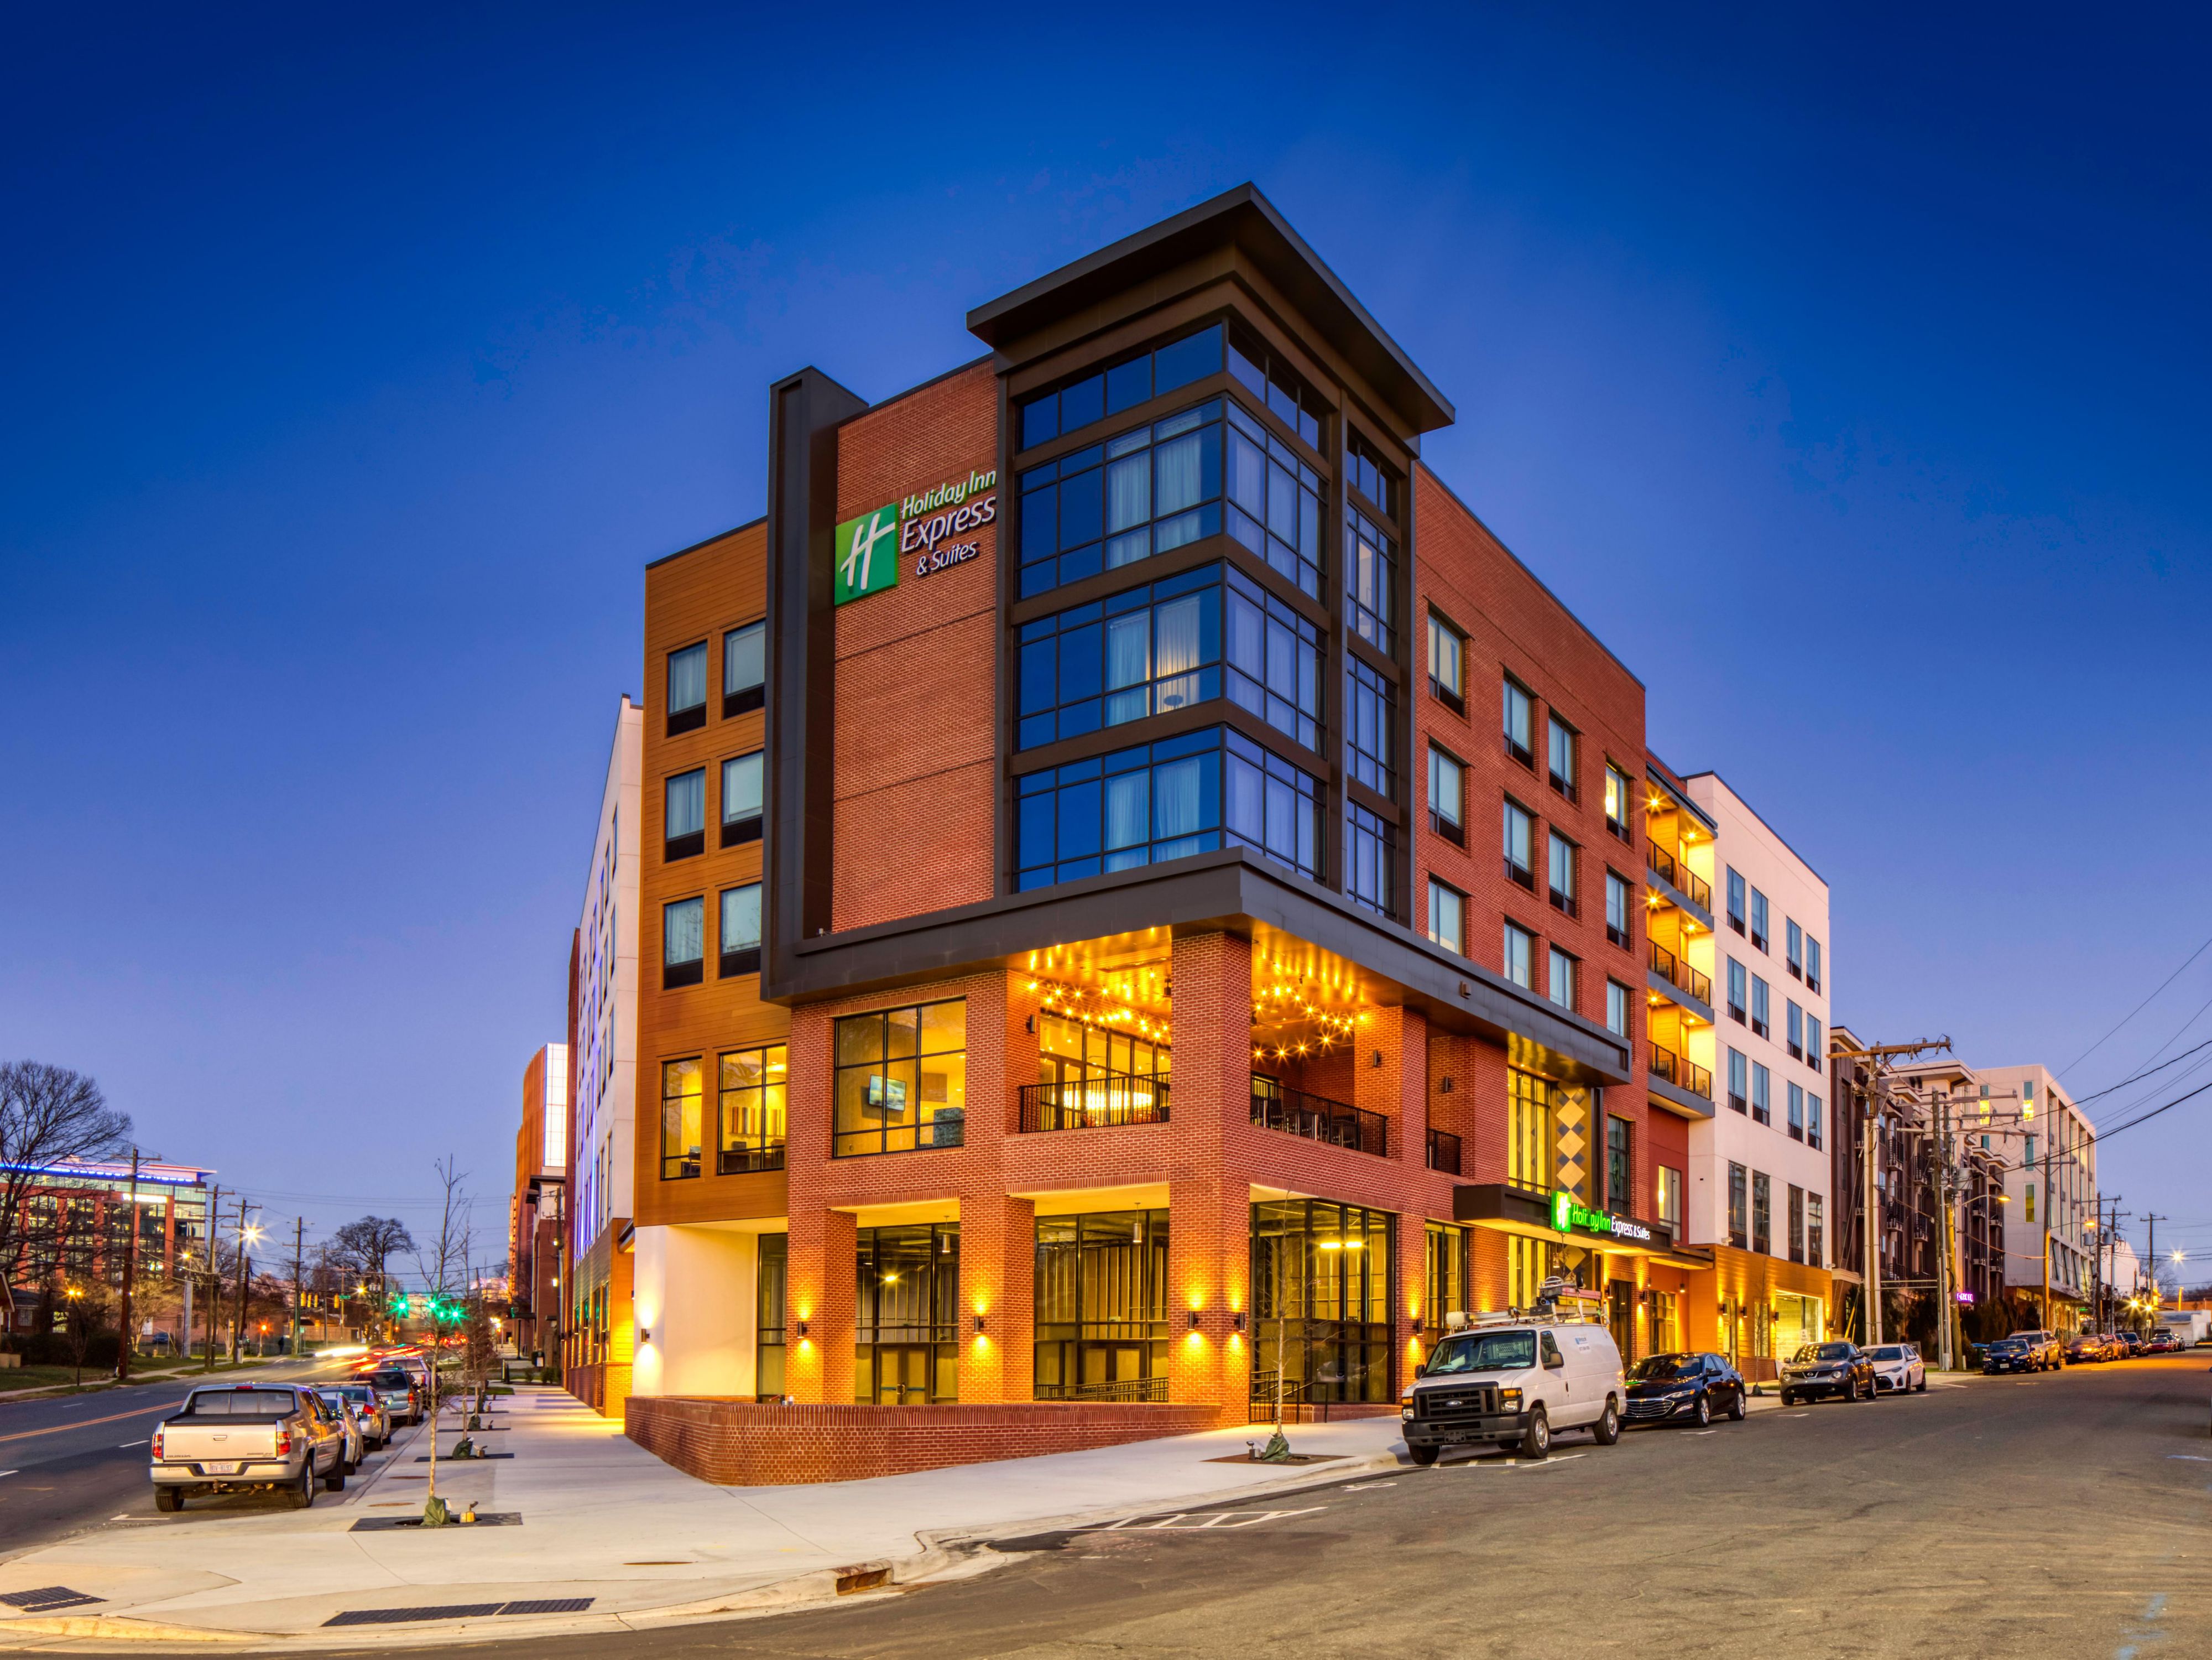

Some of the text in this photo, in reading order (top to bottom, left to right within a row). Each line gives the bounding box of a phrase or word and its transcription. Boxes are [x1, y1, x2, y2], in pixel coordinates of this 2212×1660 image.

[901, 470, 995, 519] Holiday Inn
[901, 496, 996, 552] Express
[916, 542, 977, 575] & Suites
[1573, 1203, 1650, 1240] Holiay Inn Express & Suites
